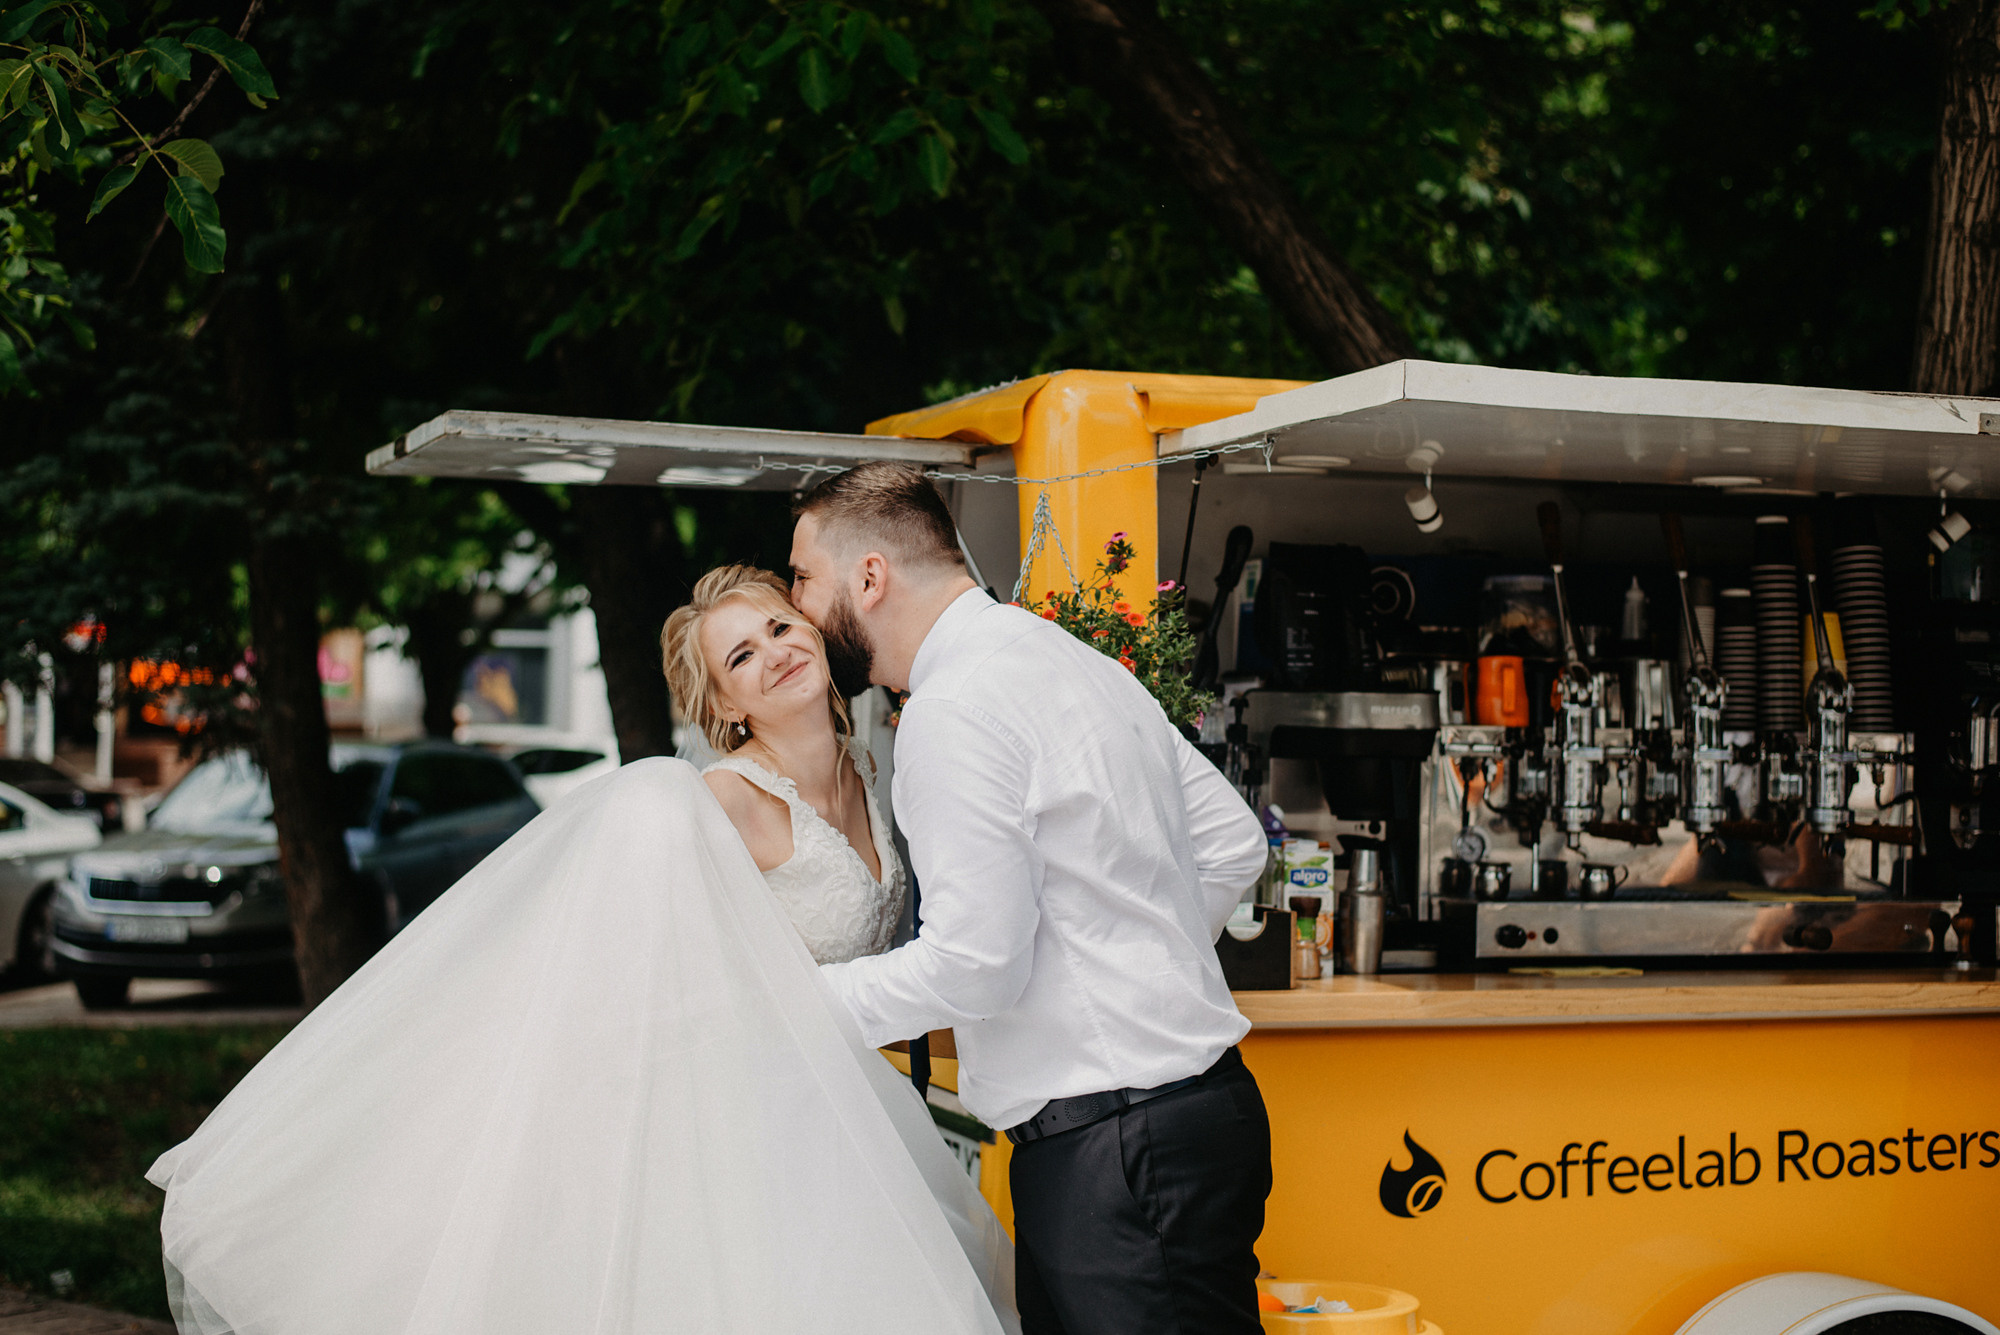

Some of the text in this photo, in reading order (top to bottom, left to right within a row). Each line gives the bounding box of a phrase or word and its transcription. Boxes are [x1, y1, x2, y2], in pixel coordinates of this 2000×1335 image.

[1292, 869, 1326, 885] alpro
[1475, 1127, 2000, 1204] Coffeelab Roasters
